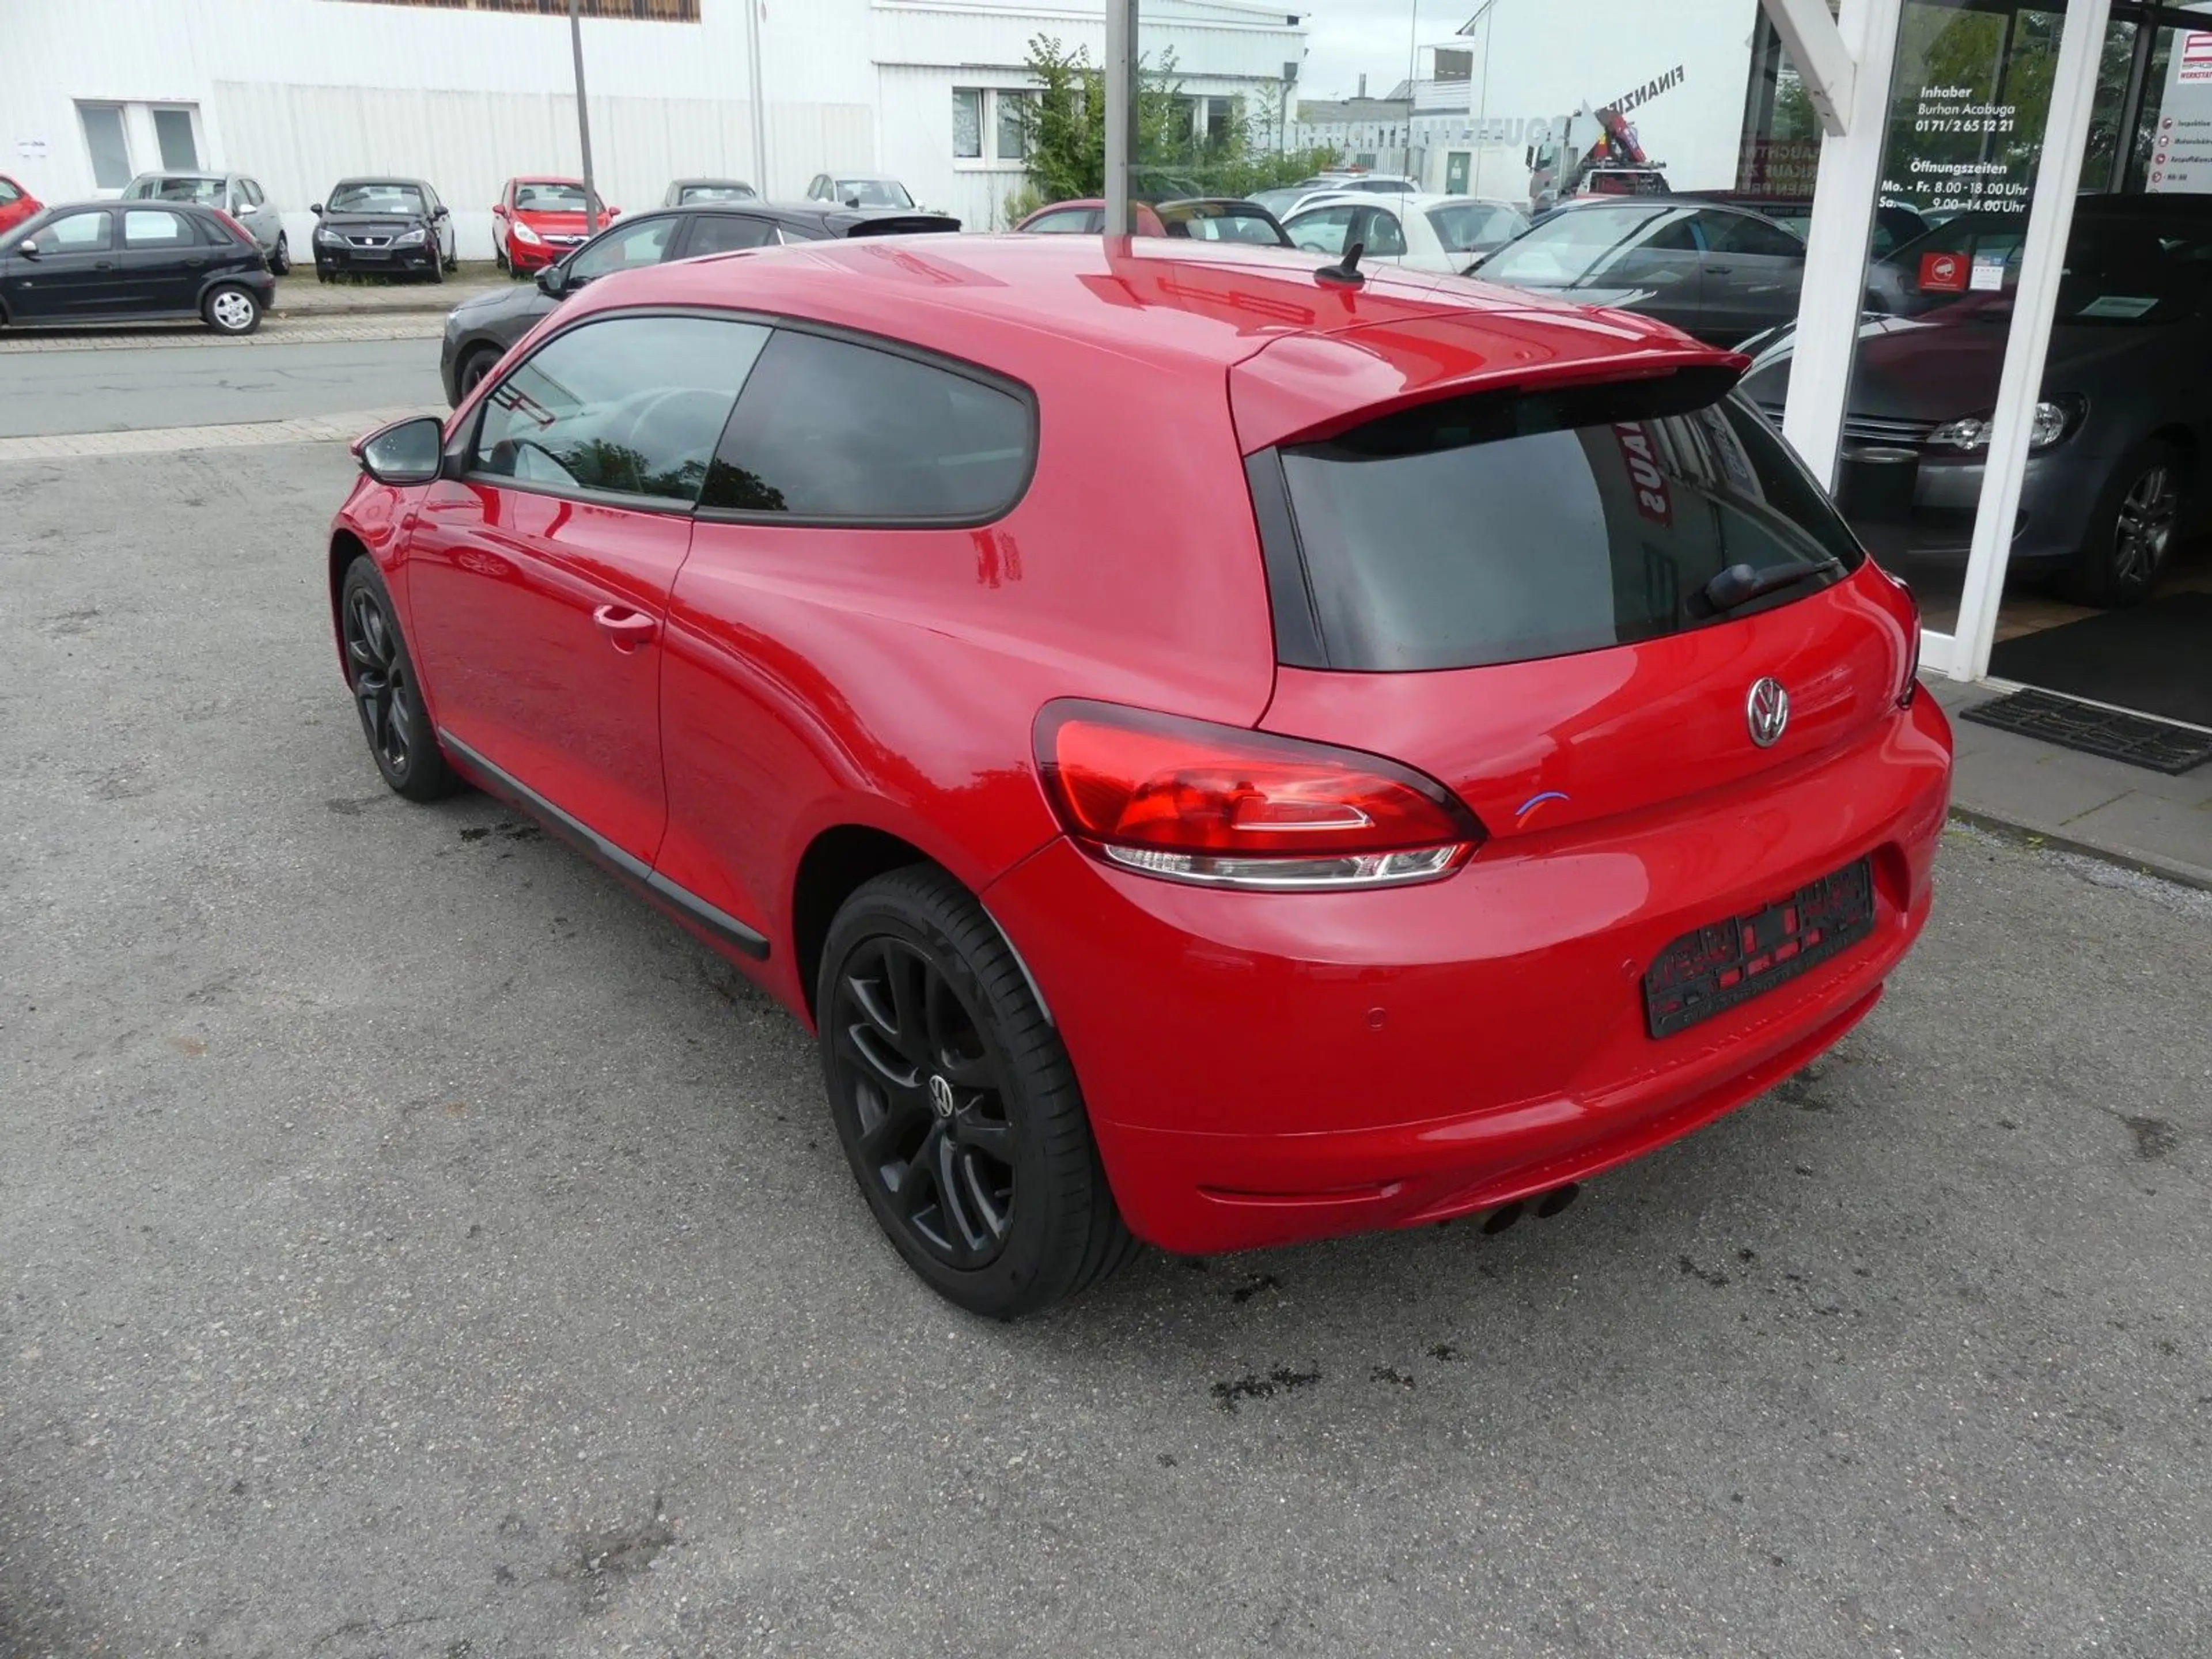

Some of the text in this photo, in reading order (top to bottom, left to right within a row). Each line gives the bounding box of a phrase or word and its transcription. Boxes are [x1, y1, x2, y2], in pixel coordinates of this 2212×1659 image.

[1921, 86, 1972, 98] Inhaber
[1918, 103, 2015, 118] Burhan Acabuga
[1910, 158, 2008, 176] Öffnungszeiten
[1881, 180, 1903, 192] Mo.
[1916, 181, 1930, 192] Fr.
[2005, 186, 2029, 196] Uhr
[1878, 196, 1896, 208] Sa.
[2002, 203, 2026, 213] Uhr
